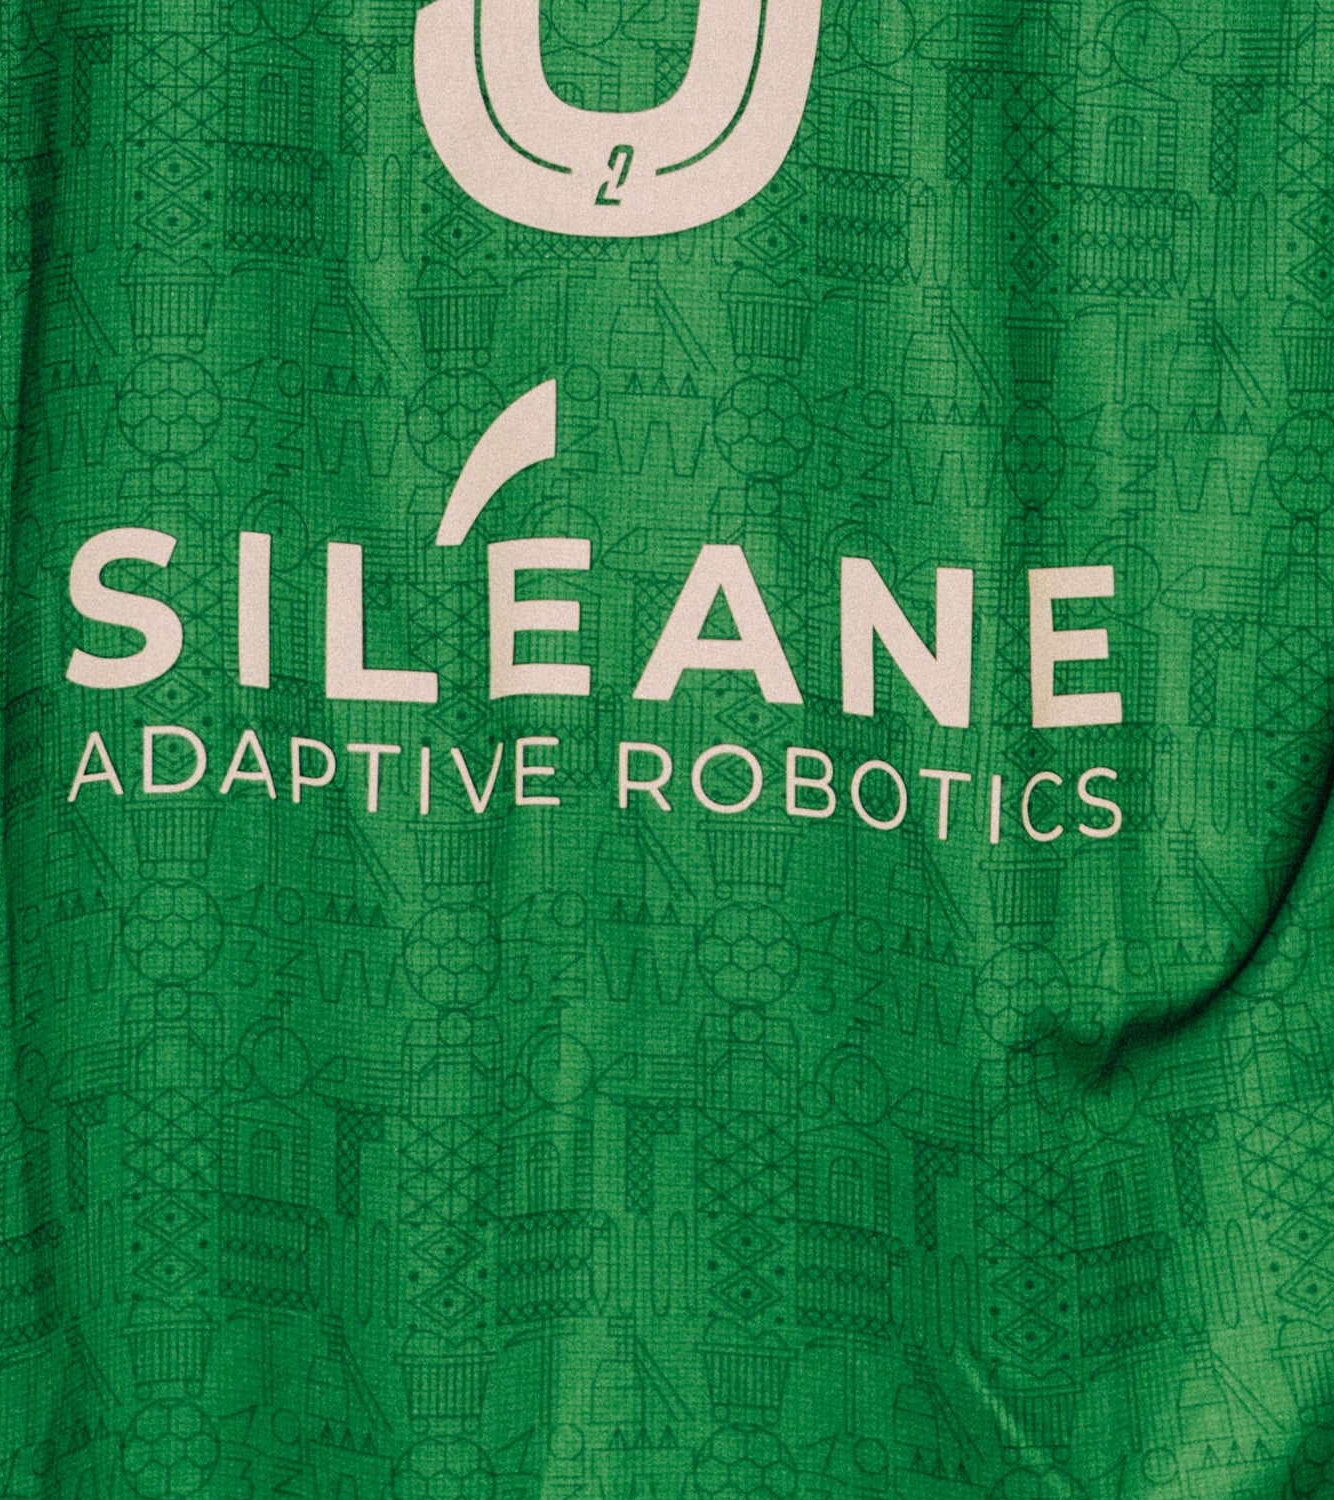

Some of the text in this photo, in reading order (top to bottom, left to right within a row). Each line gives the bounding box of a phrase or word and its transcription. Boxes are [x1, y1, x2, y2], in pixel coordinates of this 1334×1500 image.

[65, 378, 1123, 728] SILÉANE
[68, 725, 1123, 845] ADAPTIVE ROBOTICS
